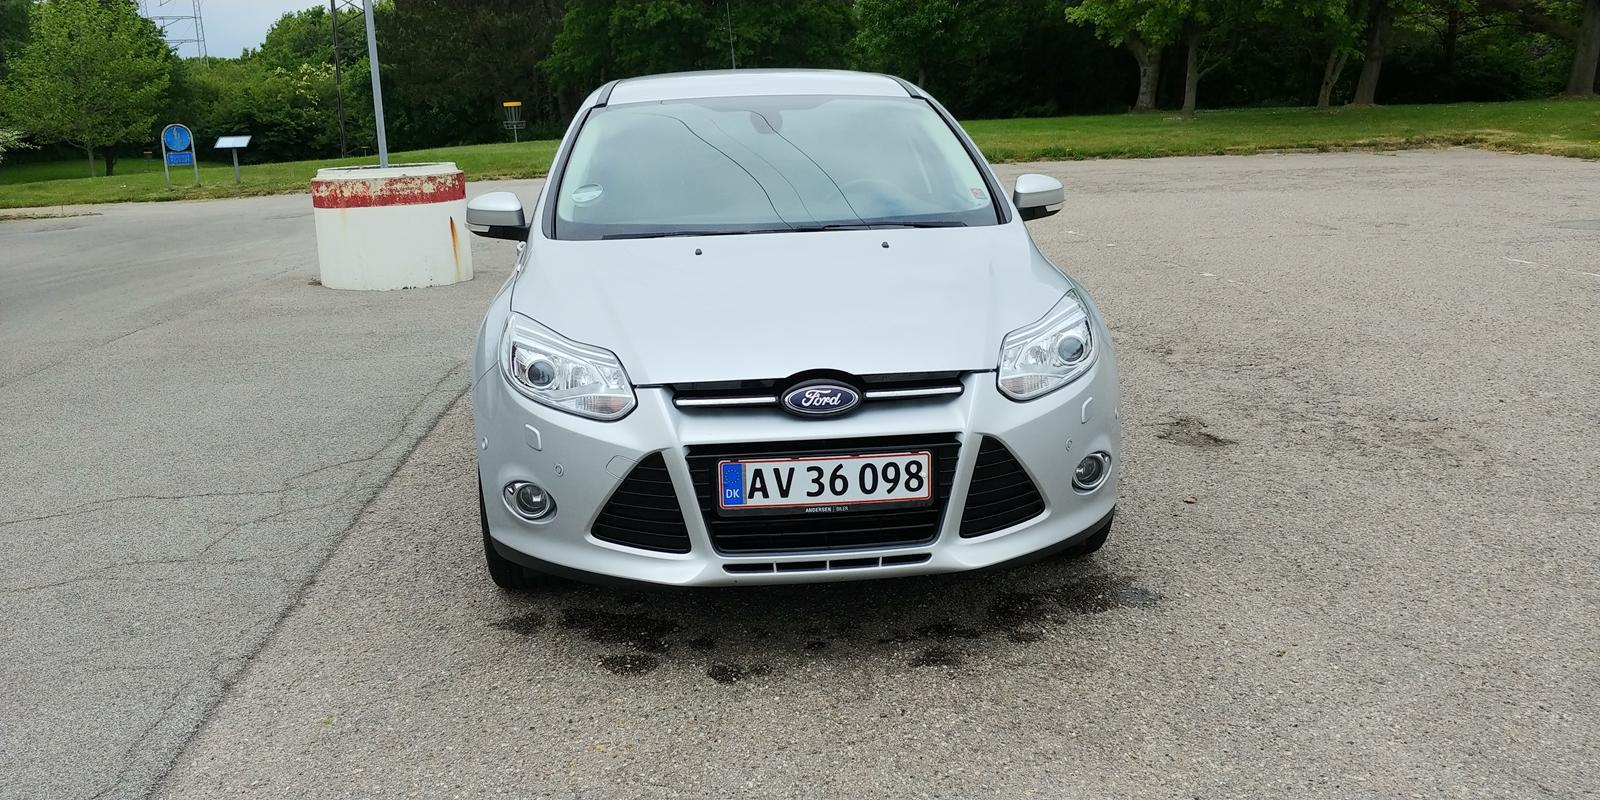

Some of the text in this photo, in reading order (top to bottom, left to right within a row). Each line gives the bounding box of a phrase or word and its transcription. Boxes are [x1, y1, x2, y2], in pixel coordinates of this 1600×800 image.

[802, 389, 842, 407] Ford
[748, 460, 924, 499] AV 36 098
[725, 489, 740, 499] DK
